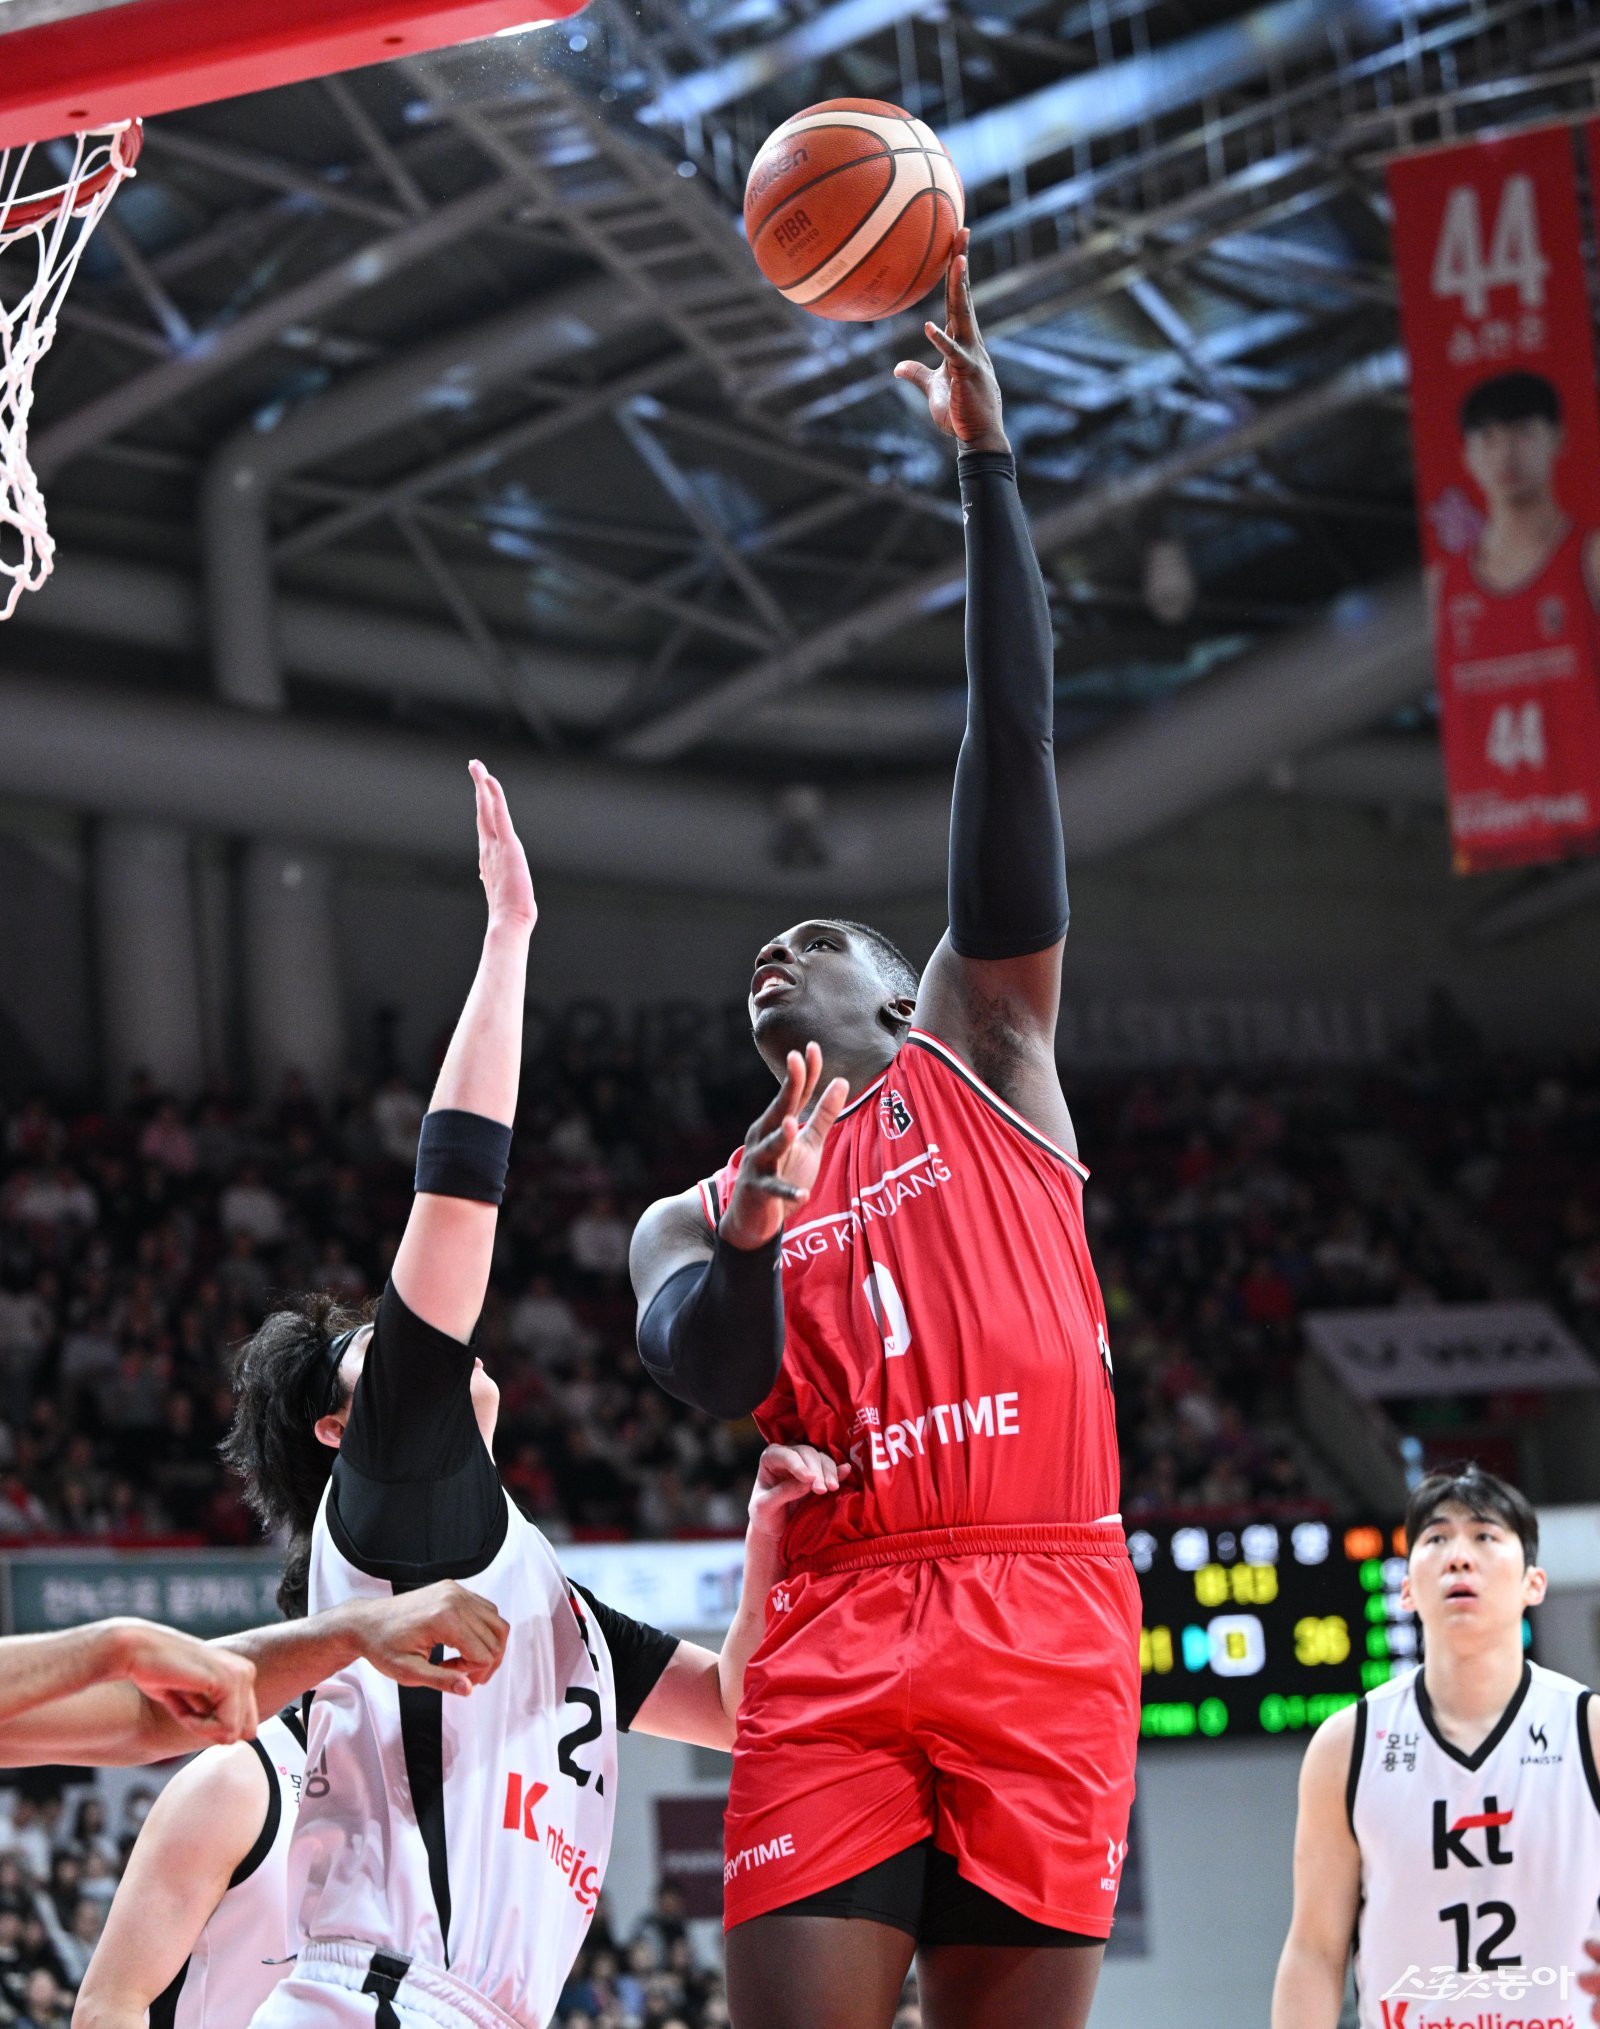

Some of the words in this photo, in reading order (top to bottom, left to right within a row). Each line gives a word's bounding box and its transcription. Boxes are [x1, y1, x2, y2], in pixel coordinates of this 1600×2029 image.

[773, 208, 812, 248] FIBA
[1431, 173, 1549, 320] 44
[1432, 1795, 1514, 1870] kt
[1438, 1900, 1522, 1973] 12
